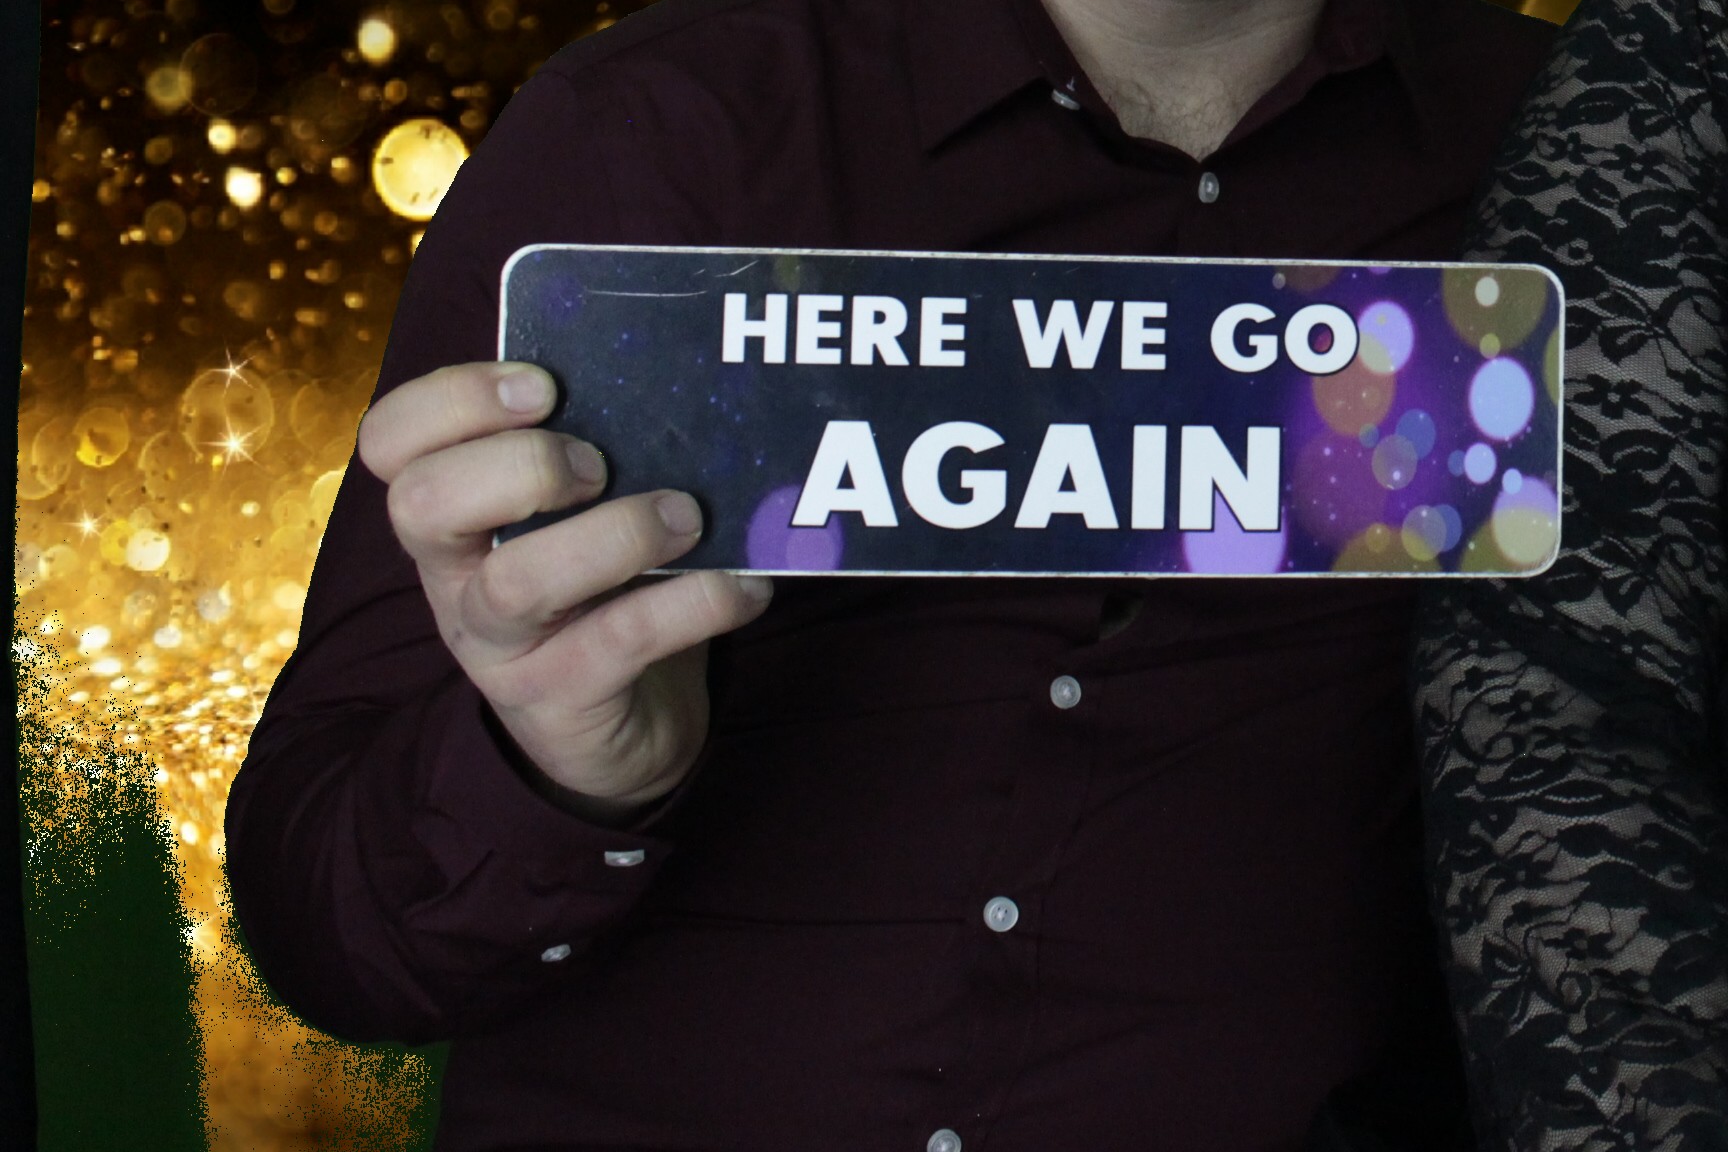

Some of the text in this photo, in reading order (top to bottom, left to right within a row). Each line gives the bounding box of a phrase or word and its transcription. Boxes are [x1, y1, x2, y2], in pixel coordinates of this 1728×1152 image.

[721, 292, 1361, 375] HERE WE GO
[791, 418, 1283, 532] AGAIN
